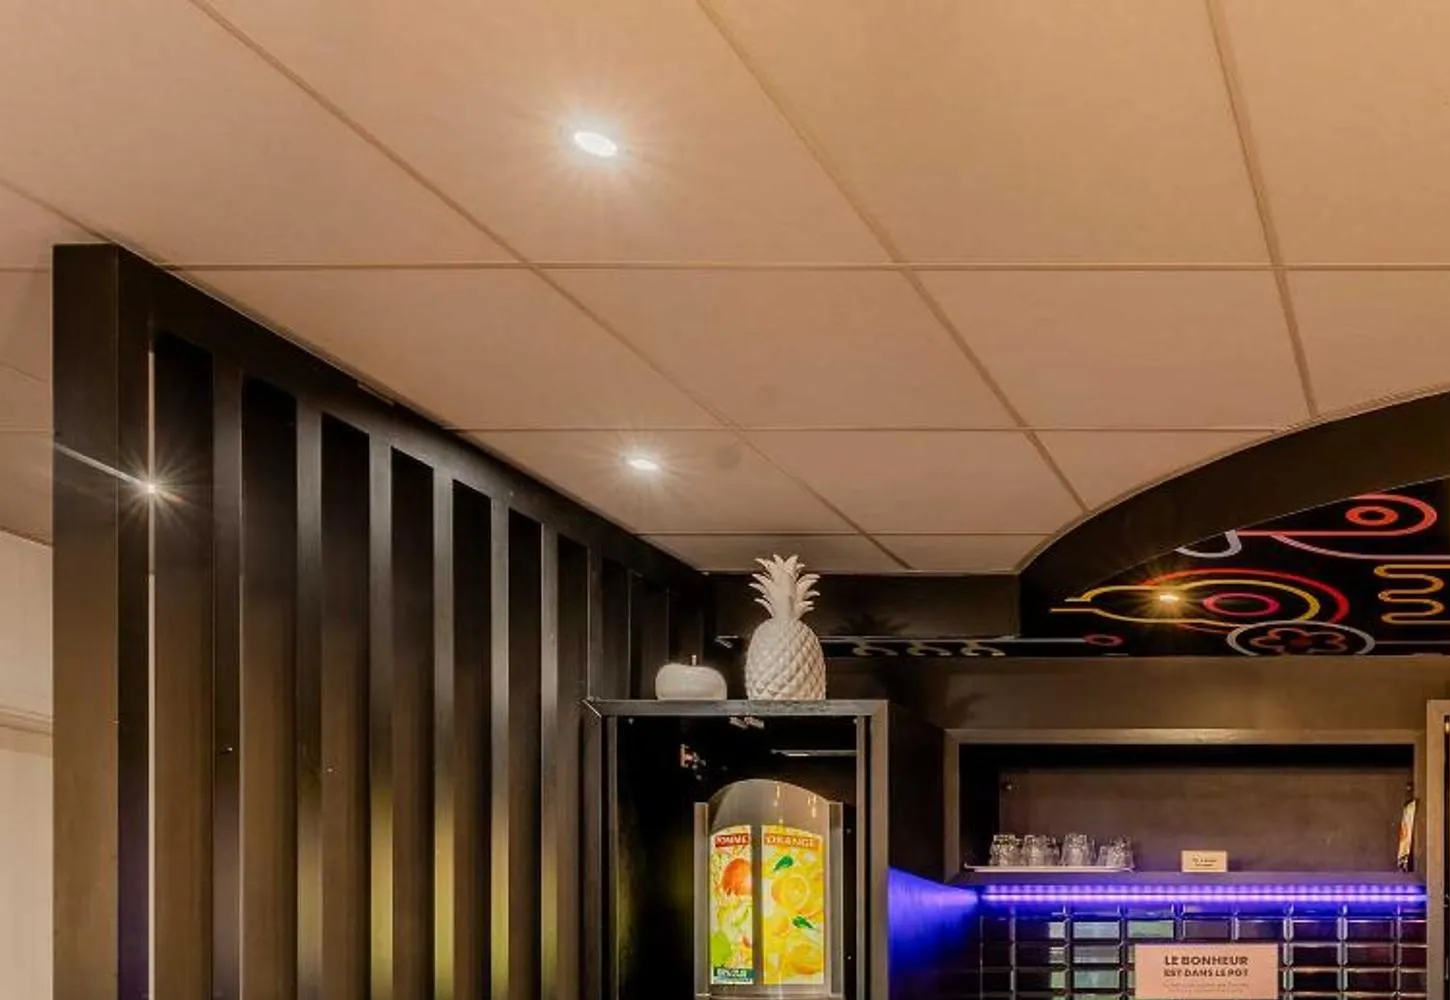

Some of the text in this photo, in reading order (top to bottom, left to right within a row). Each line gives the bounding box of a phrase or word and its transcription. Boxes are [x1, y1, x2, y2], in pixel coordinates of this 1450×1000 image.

[1165, 956, 1248, 965] LE BONHEUR
[1184, 968, 1213, 977] DANS
[1215, 968, 1226, 977] LE
[1227, 968, 1248, 977] POT
